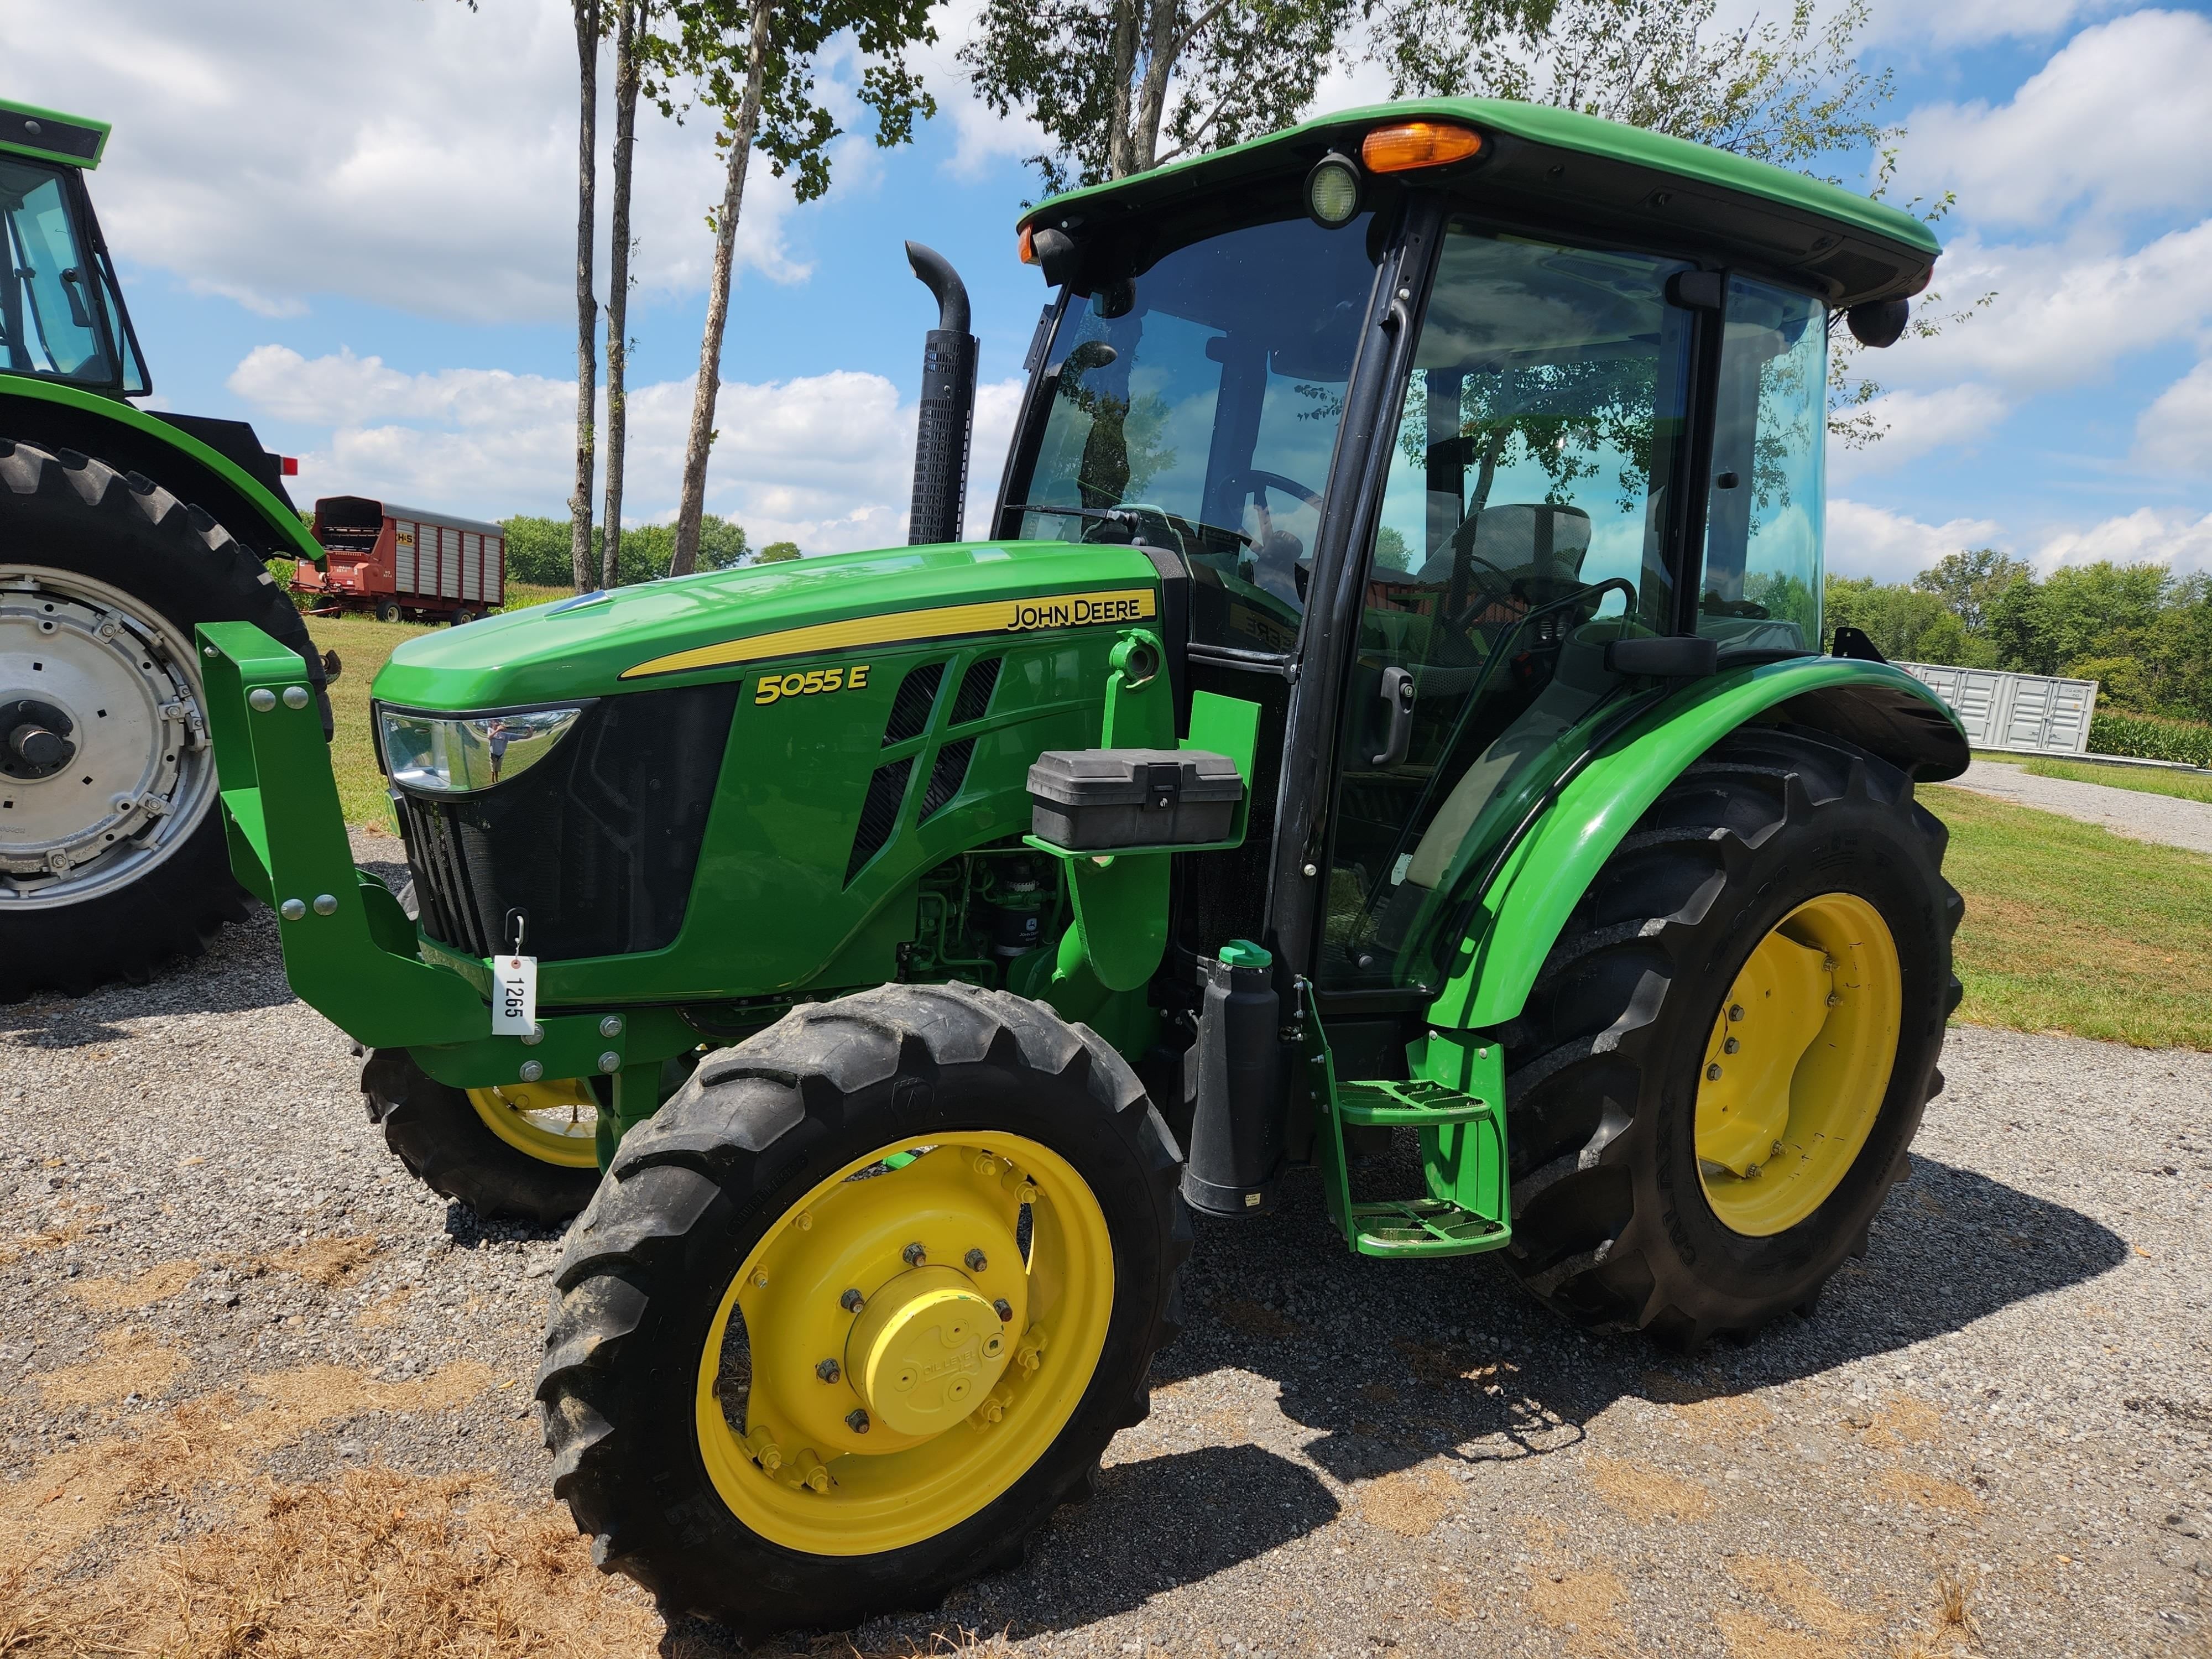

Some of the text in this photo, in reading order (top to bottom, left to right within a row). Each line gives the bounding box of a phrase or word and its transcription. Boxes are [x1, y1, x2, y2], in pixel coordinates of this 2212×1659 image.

[1008, 599, 1140, 628] JOHN DEERE
[754, 665, 872, 706] 5055 E
[505, 977, 524, 1018] 1265
[924, 1350, 975, 1375] OIL LEVEL
